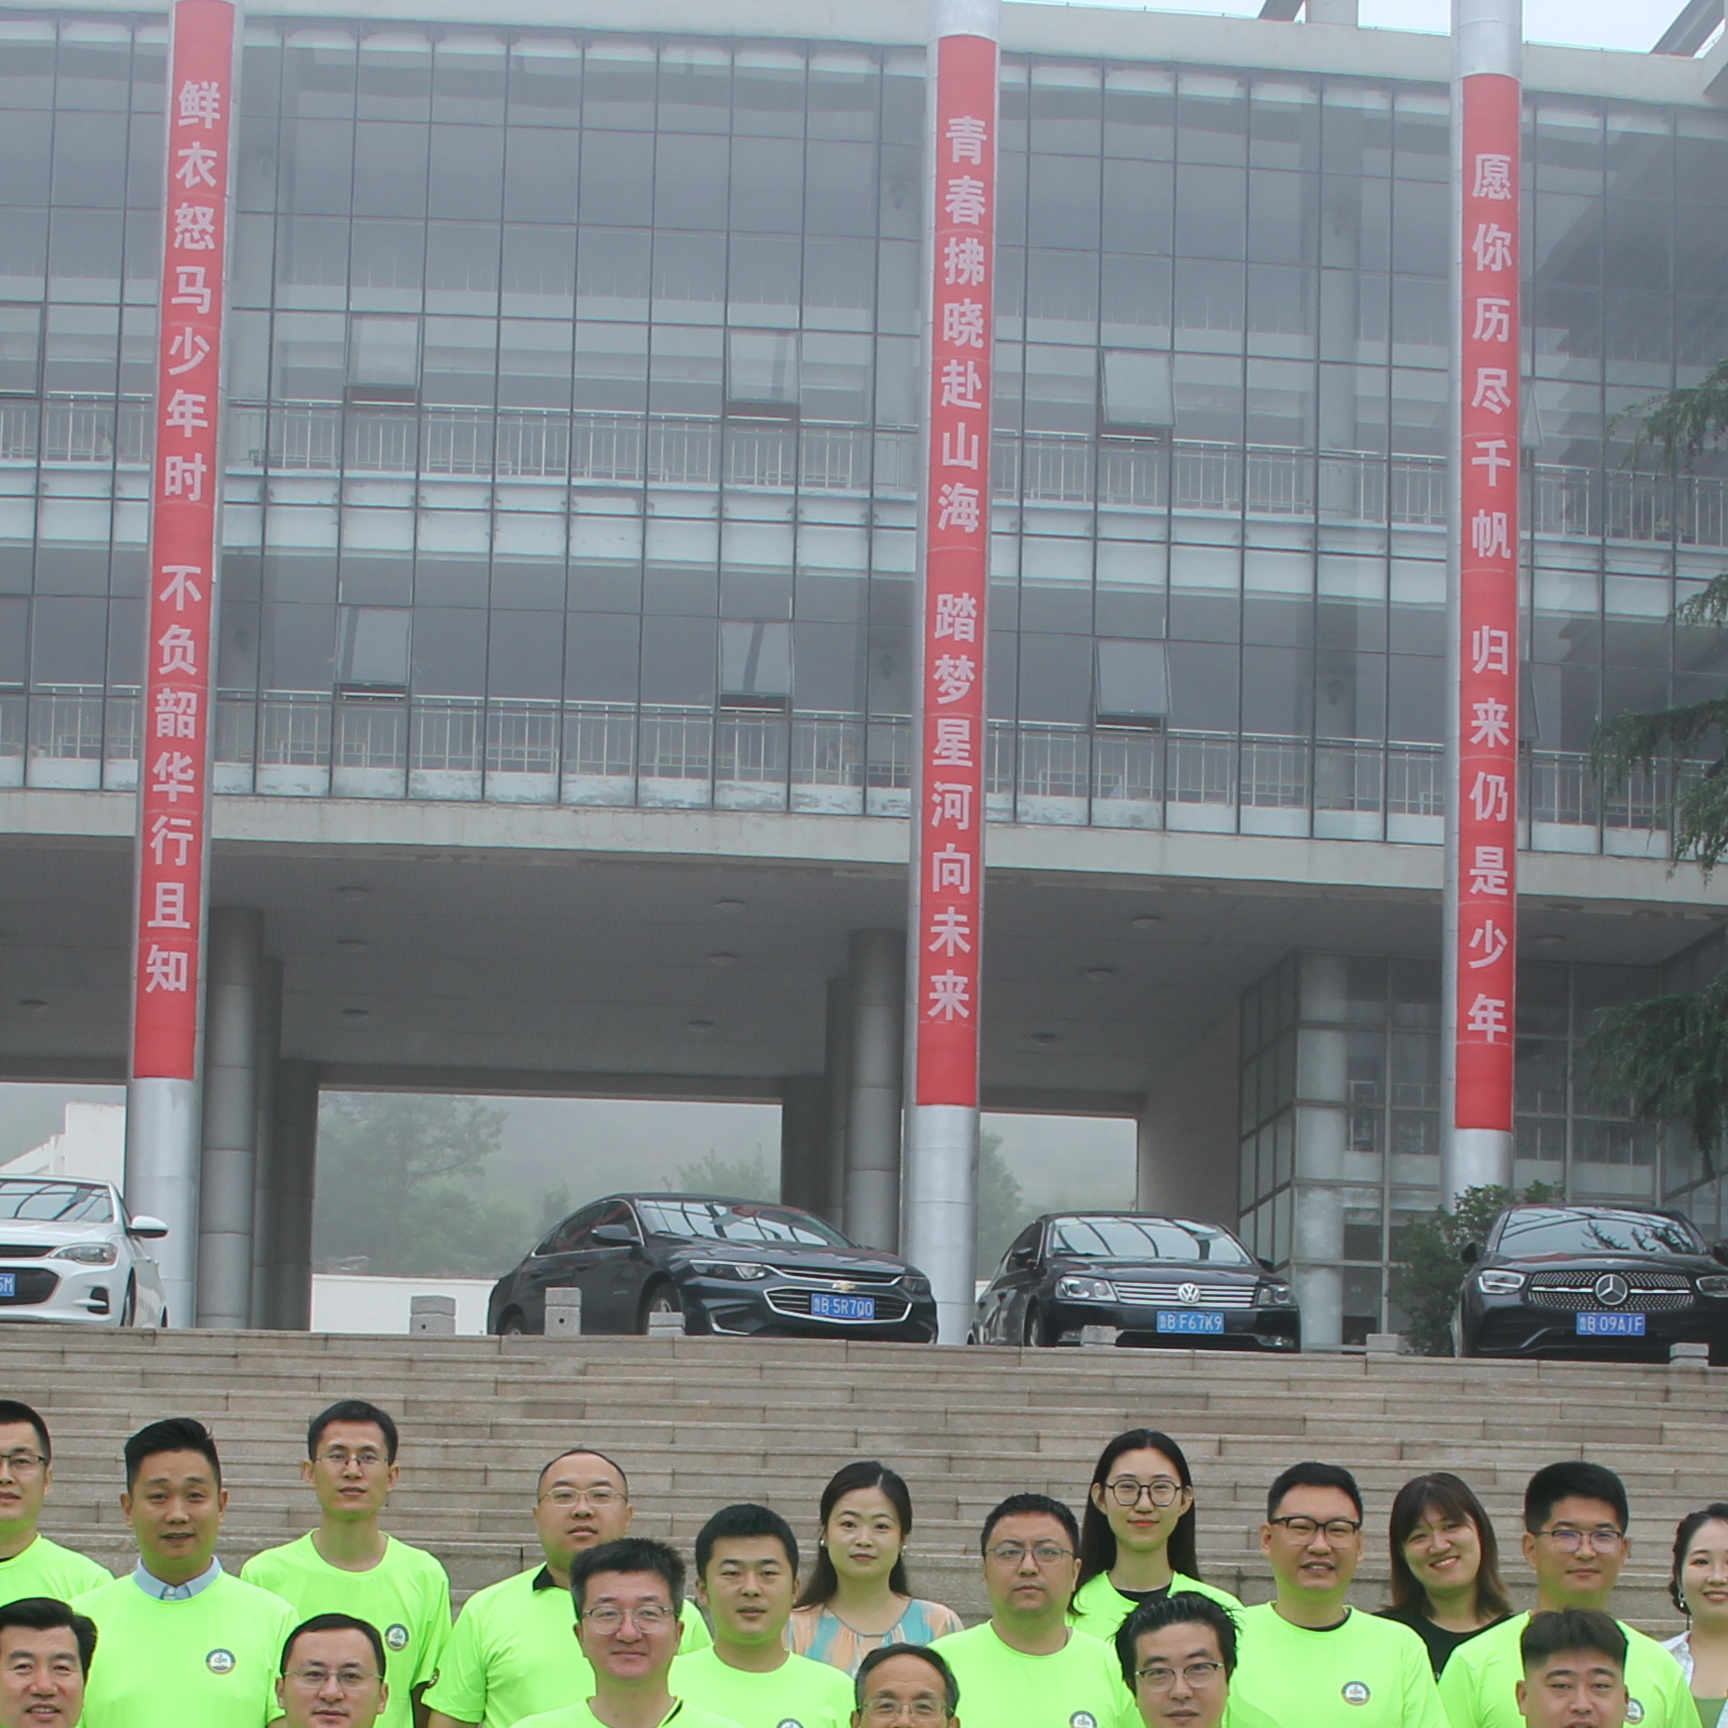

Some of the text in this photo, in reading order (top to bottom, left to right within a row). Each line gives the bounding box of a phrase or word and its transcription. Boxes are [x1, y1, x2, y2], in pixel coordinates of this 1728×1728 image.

[146, 80, 221, 994] 鲜衣怒马少年时 不负韶华行且知
[929, 115, 988, 1021] 青春拂晓赴山海 踏梦星河向未来
[1468, 153, 1513, 1043] 愿你历尽千帆 归来仍是少年
